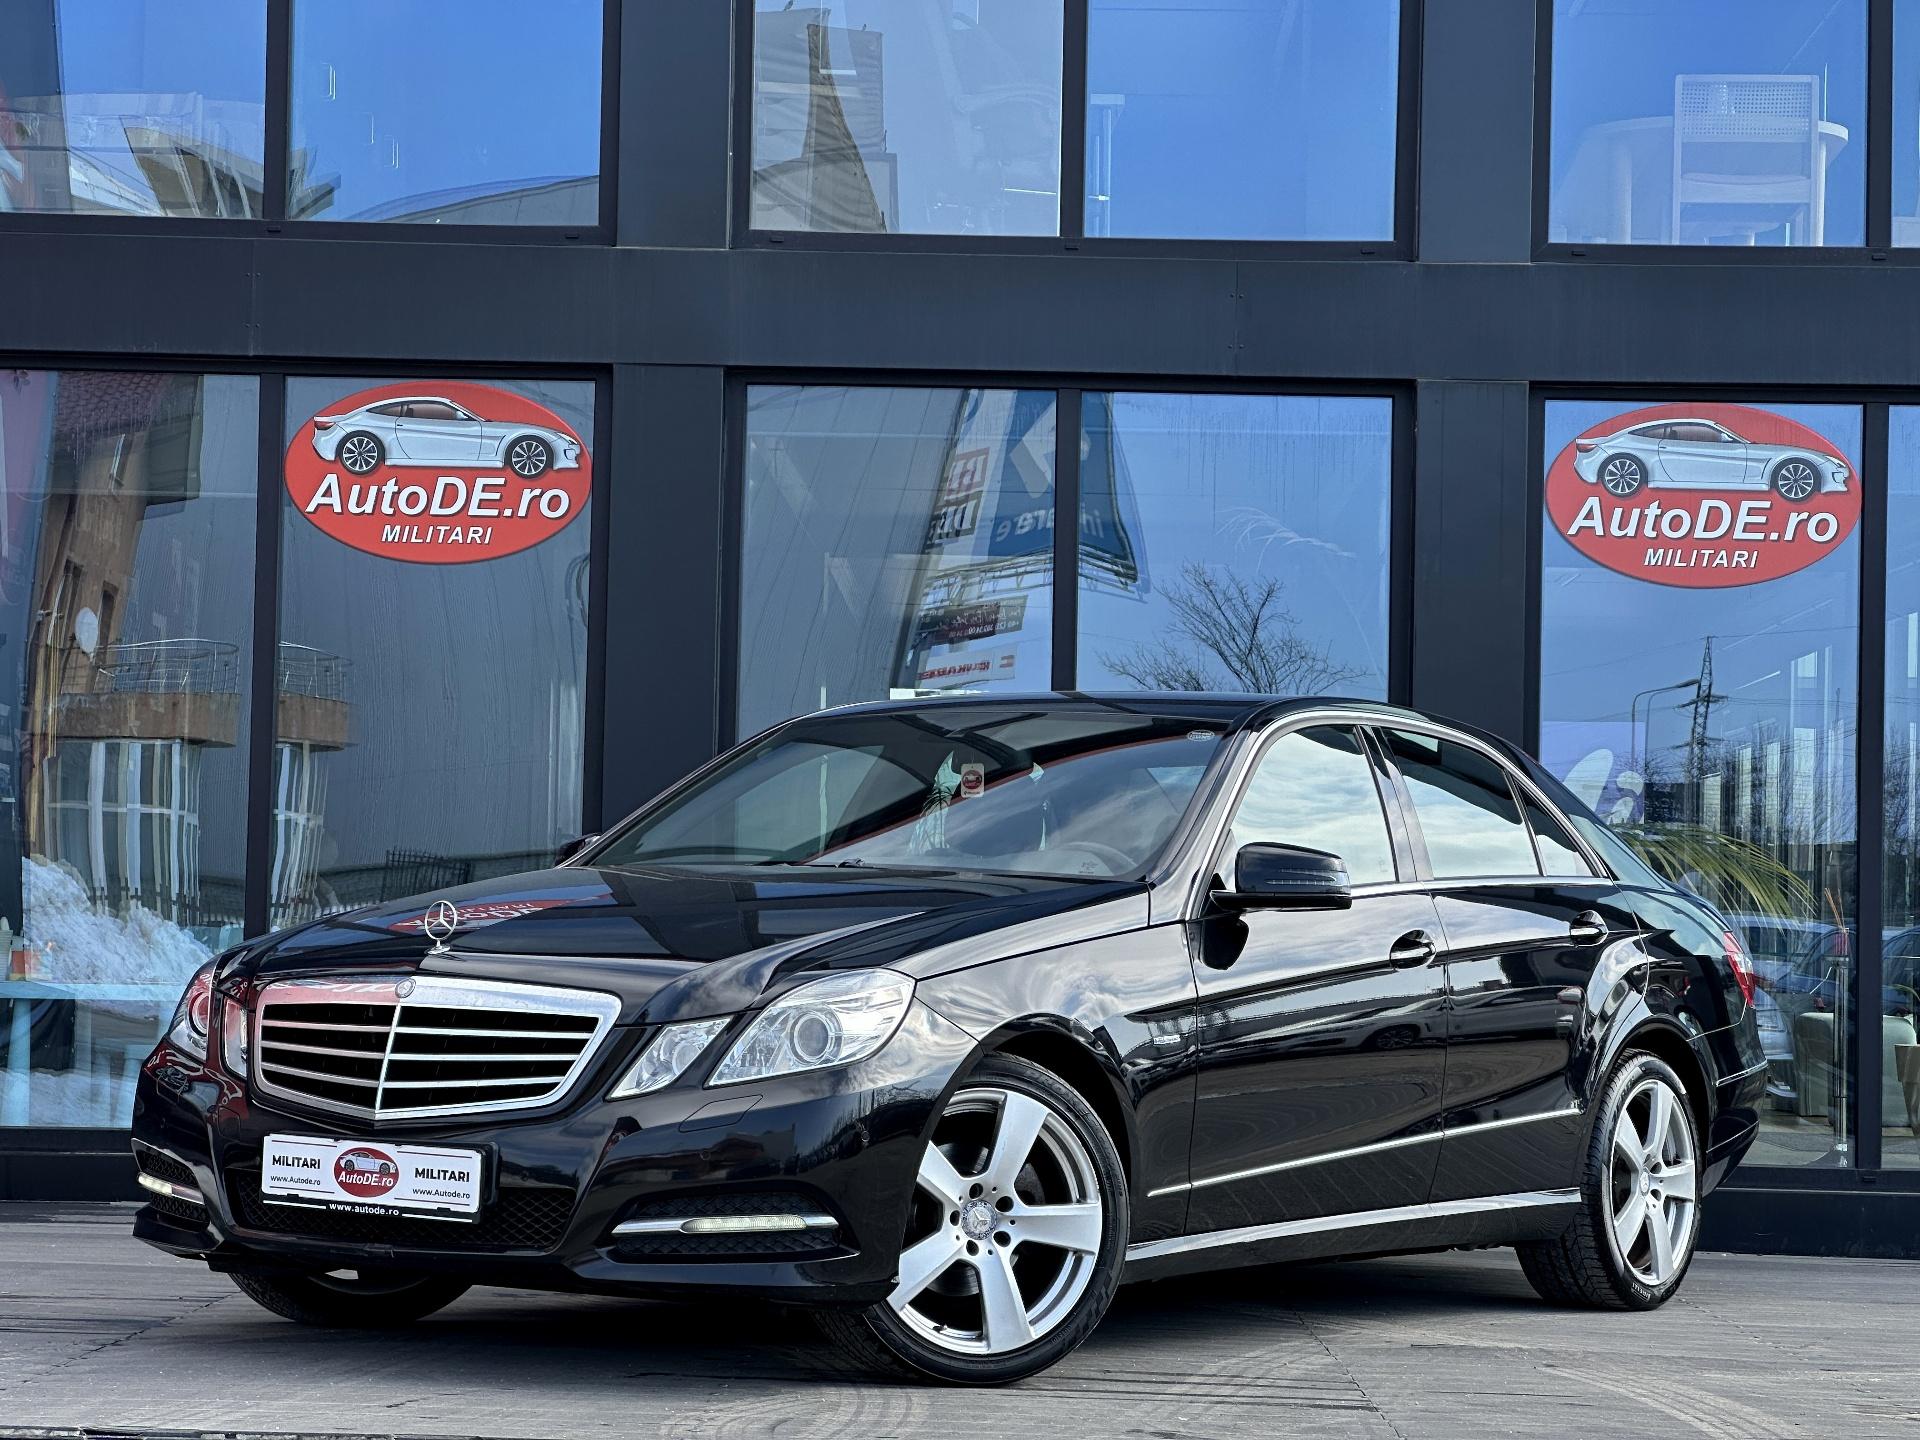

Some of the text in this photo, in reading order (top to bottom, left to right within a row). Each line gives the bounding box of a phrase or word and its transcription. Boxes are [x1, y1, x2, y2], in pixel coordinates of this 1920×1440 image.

[305, 473, 571, 520] AutoDE.ro
[1567, 496, 1839, 542] AutoDE.ro
[381, 525, 493, 545] MILITARI
[1643, 548, 1759, 569] MILITARI
[272, 1154, 321, 1170] MILITARI
[270, 1175, 321, 1186] www.Autode.ro
[338, 1171, 394, 1187] AutoDE.ro
[414, 1167, 470, 1183] MILITARI
[412, 1187, 471, 1200] www.Autode.ro
[328, 1203, 400, 1216] www.autode.ro
